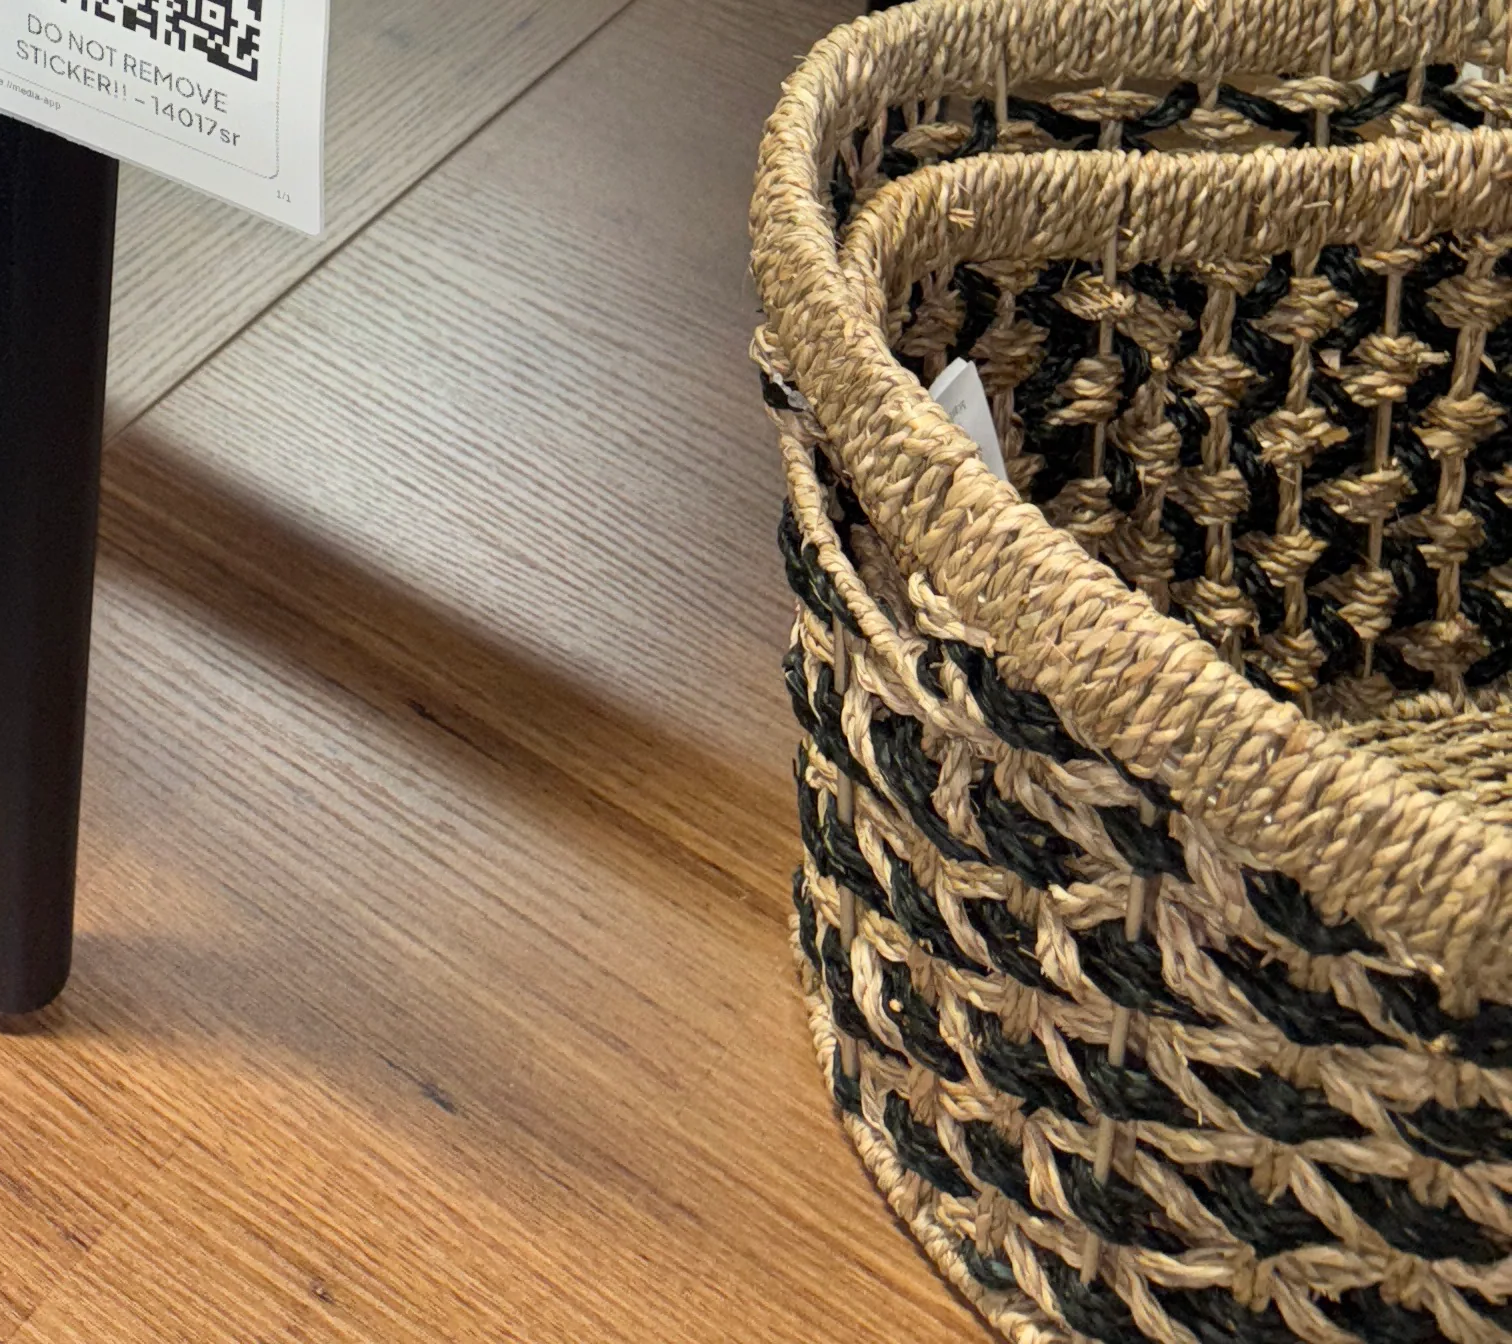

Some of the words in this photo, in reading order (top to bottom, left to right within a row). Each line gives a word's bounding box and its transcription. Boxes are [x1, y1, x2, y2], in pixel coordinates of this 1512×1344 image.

[16, 39, 127, 102] STICKER!!
[150, 96, 241, 146] 14017sr
[27, 13, 63, 44] DO
[68, 30, 117, 68] NOT
[123, 53, 228, 114] REMOVE
[276, 189, 292, 203] 1/1
